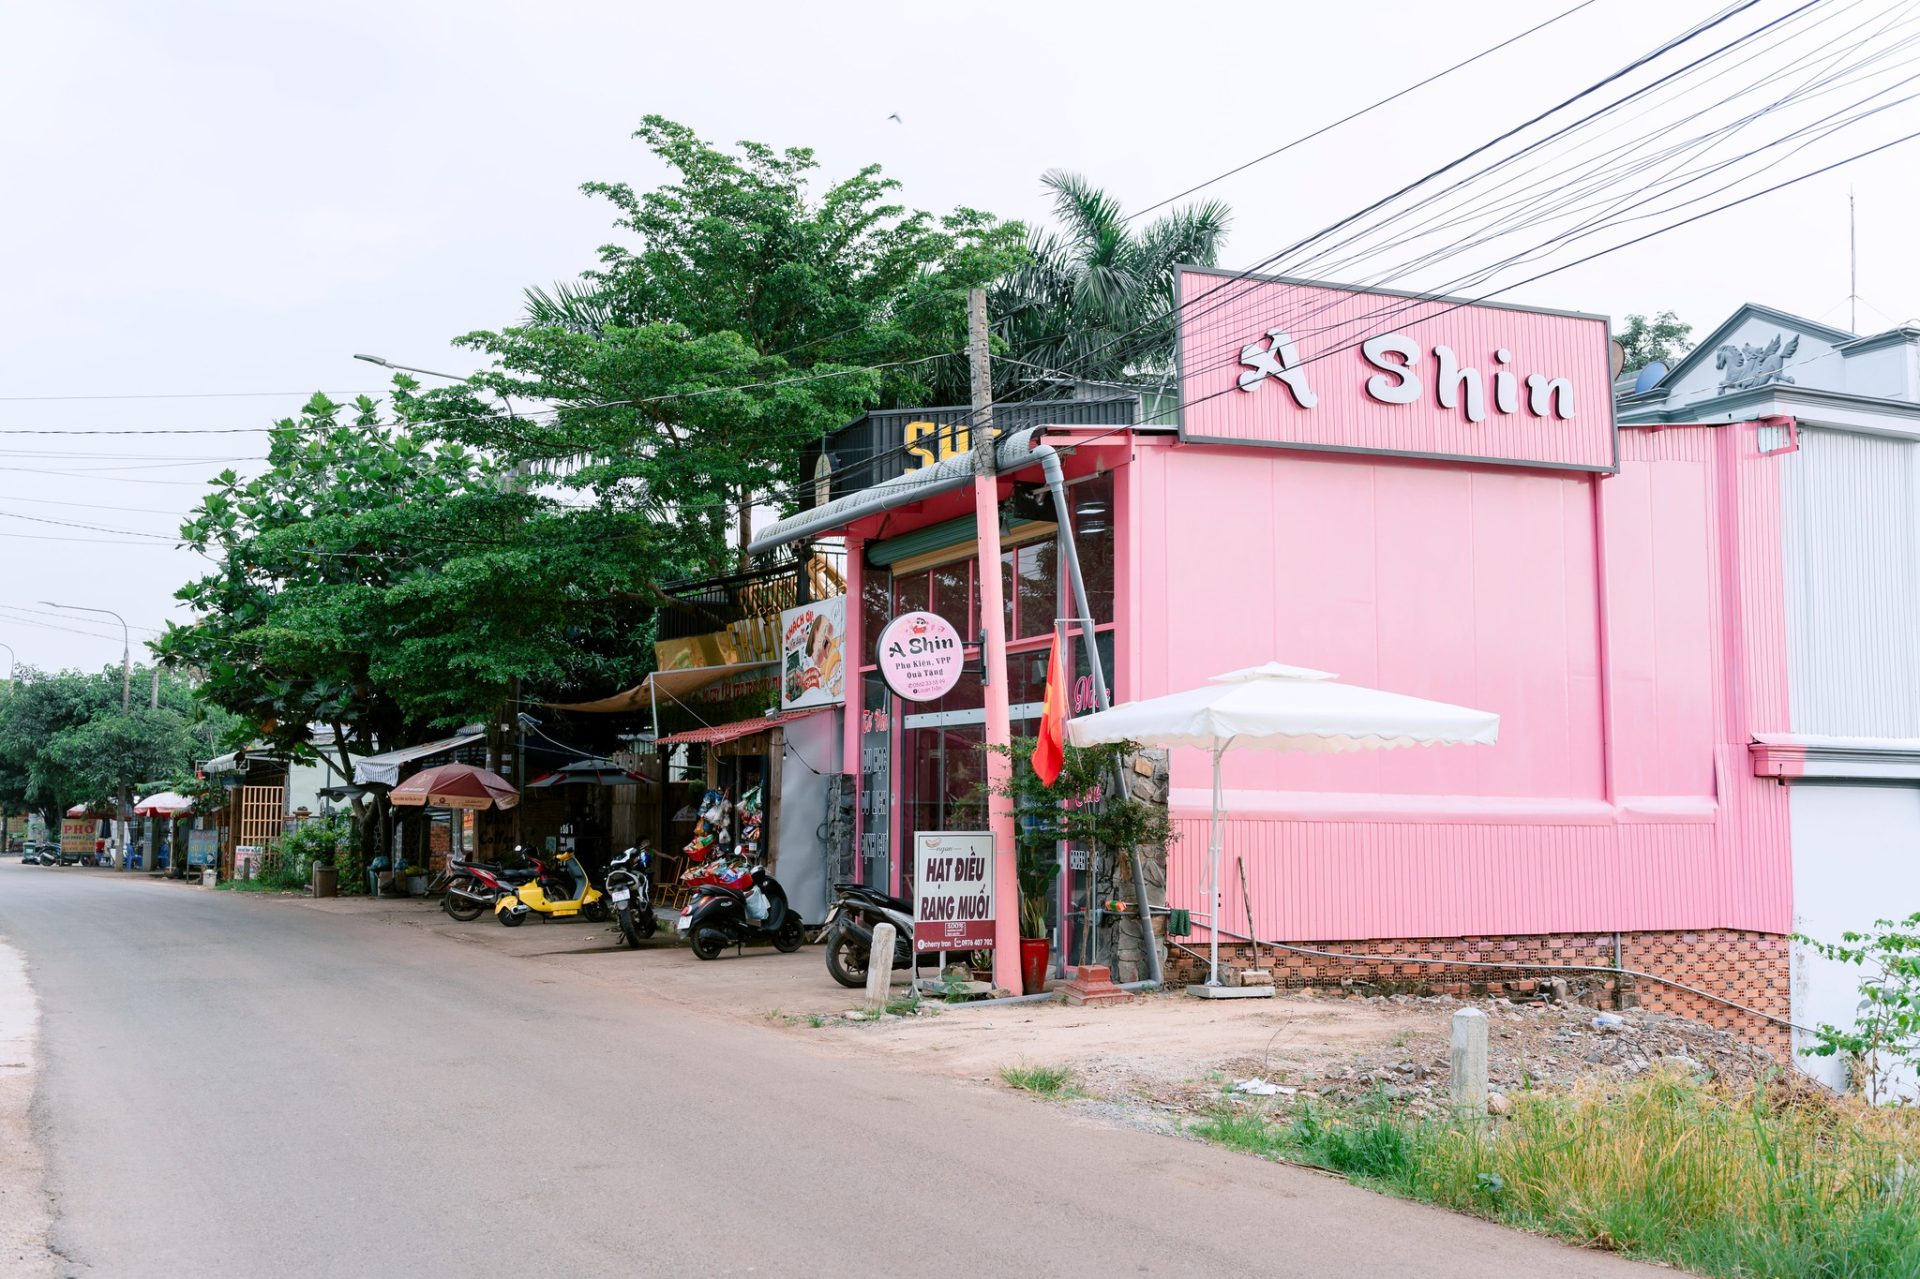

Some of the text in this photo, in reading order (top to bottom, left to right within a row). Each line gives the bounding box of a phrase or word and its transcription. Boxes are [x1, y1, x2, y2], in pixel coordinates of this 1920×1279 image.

[1237, 328, 1576, 423] A Shin
[889, 636, 954, 658] A Shin
[936, 656, 952, 665] VPP
[863, 747, 872, 773] DU
[861, 790, 870, 816] DU
[926, 845, 985, 890] HẠT ĐIỀU
[921, 884, 990, 921] RANG MUỐI
[924, 940, 940, 949] cherry
